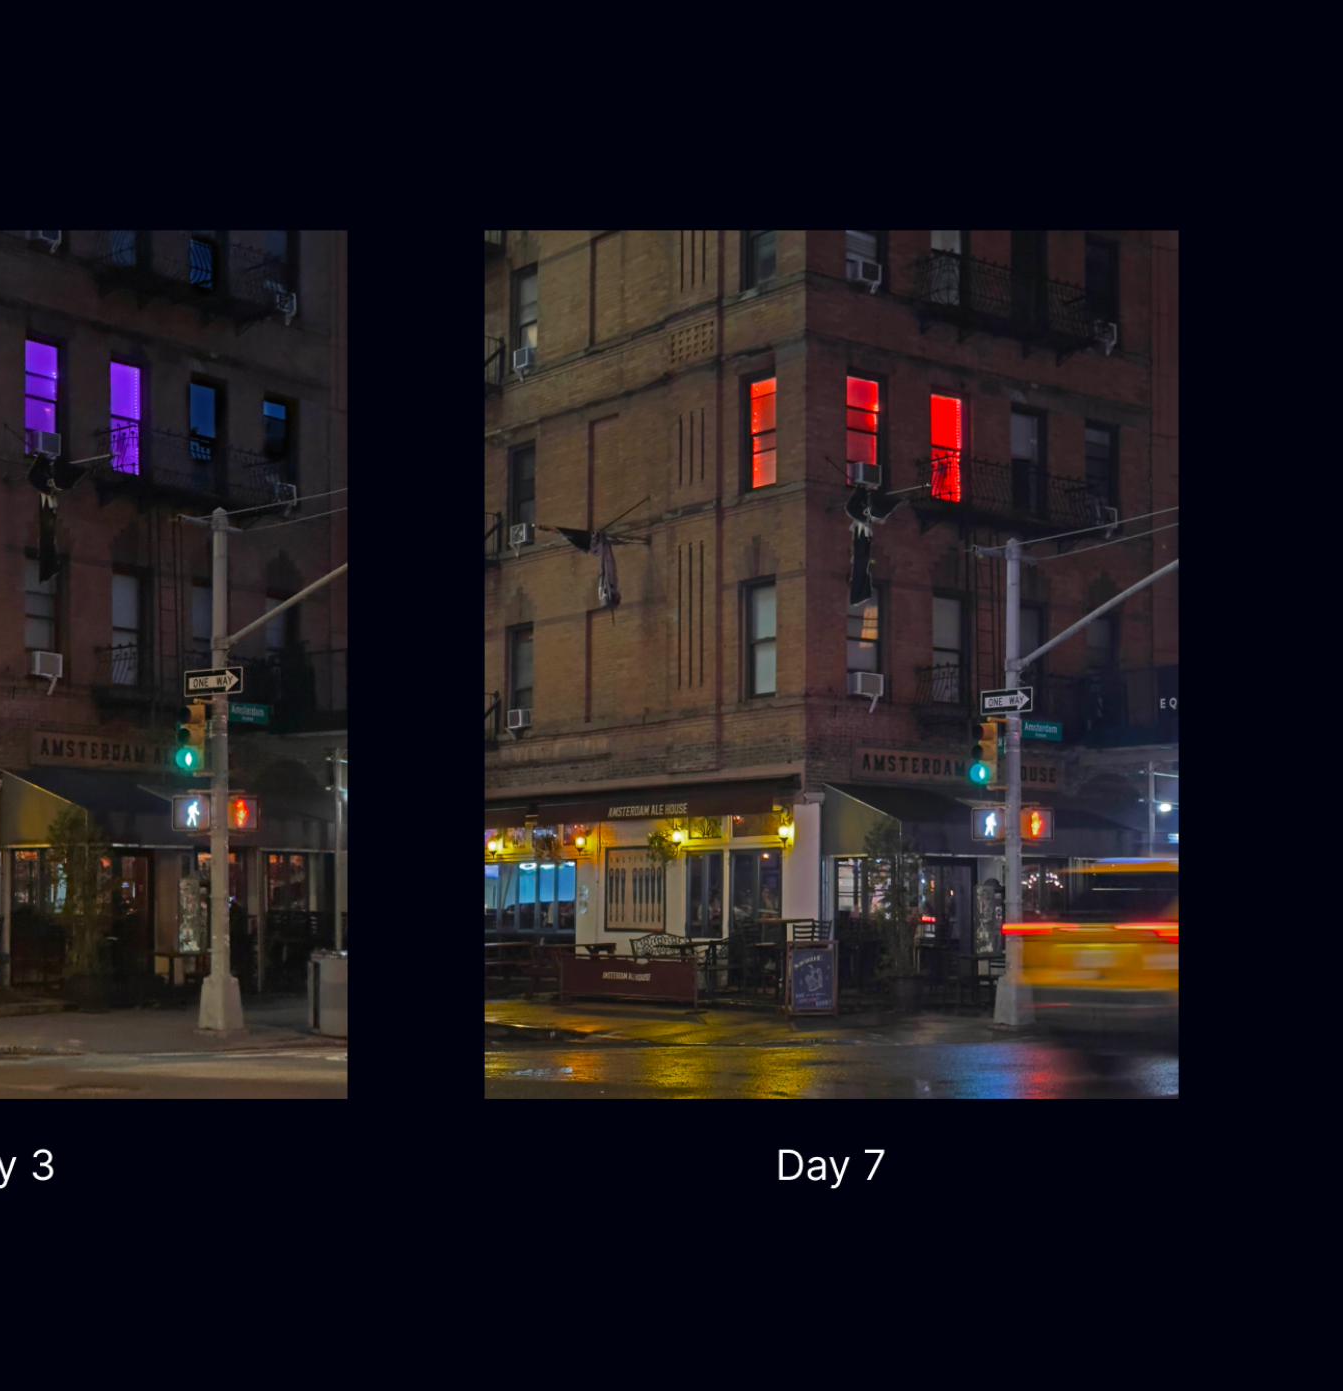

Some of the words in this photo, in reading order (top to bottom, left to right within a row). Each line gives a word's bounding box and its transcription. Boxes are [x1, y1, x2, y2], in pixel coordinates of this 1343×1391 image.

[193, 677, 208, 688] ONE
[216, 675, 234, 686] WAY
[988, 697, 1003, 707] ONE
[1009, 695, 1025, 705] WAY
[1160, 697, 1178, 710] EQ
[230, 704, 265, 718] Amsterdam
[1024, 721, 1058, 734] Amsterdam
[40, 738, 146, 763] AMSTERDAM
[862, 753, 966, 777] AMSTERDAM
[1020, 765, 1056, 783] OUSE
[607, 805, 650, 818] AMSTERDAM
[651, 804, 664, 816] ALE
[665, 802, 688, 815] HOUSE
